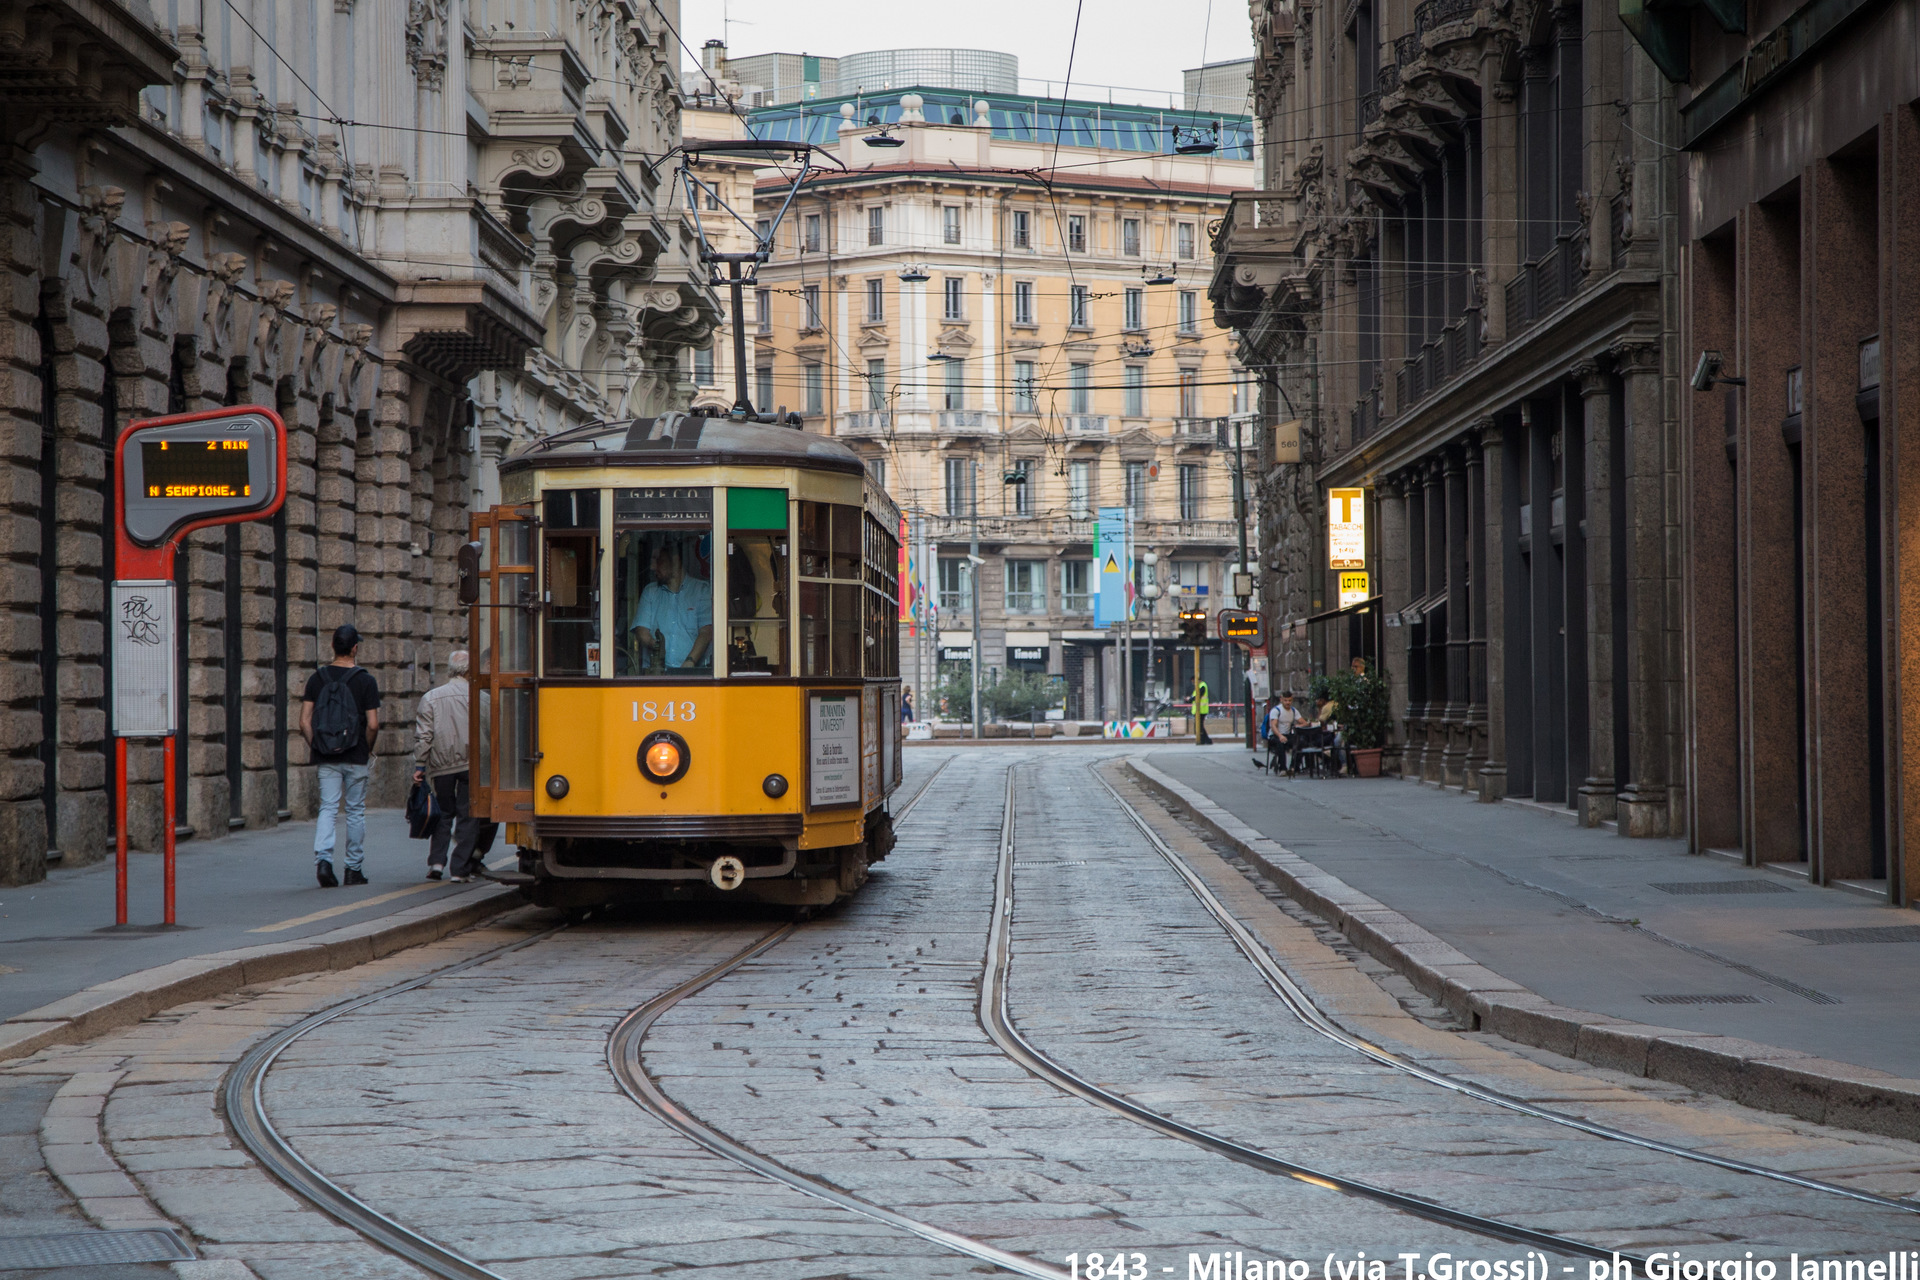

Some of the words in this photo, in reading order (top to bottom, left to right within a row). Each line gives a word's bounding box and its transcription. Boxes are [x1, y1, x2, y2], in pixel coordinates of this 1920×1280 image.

[161, 441, 168, 450] 1
[207, 441, 217, 450] 2
[223, 441, 249, 450] MIN
[166, 485, 236, 496] SEMPIONE.
[1331, 490, 1361, 523] T
[1330, 523, 1363, 531] TABACCHI
[1342, 578, 1366, 588] LOTTO
[588, 649, 600, 661] 47
[944, 648, 971, 660] limoni
[1014, 648, 1041, 660] limoni
[592, 663, 597, 674] 1
[632, 701, 696, 721] 1843
[820, 704, 846, 717] HUMANITAS
[820, 718, 845, 731] UNIVERSITY
